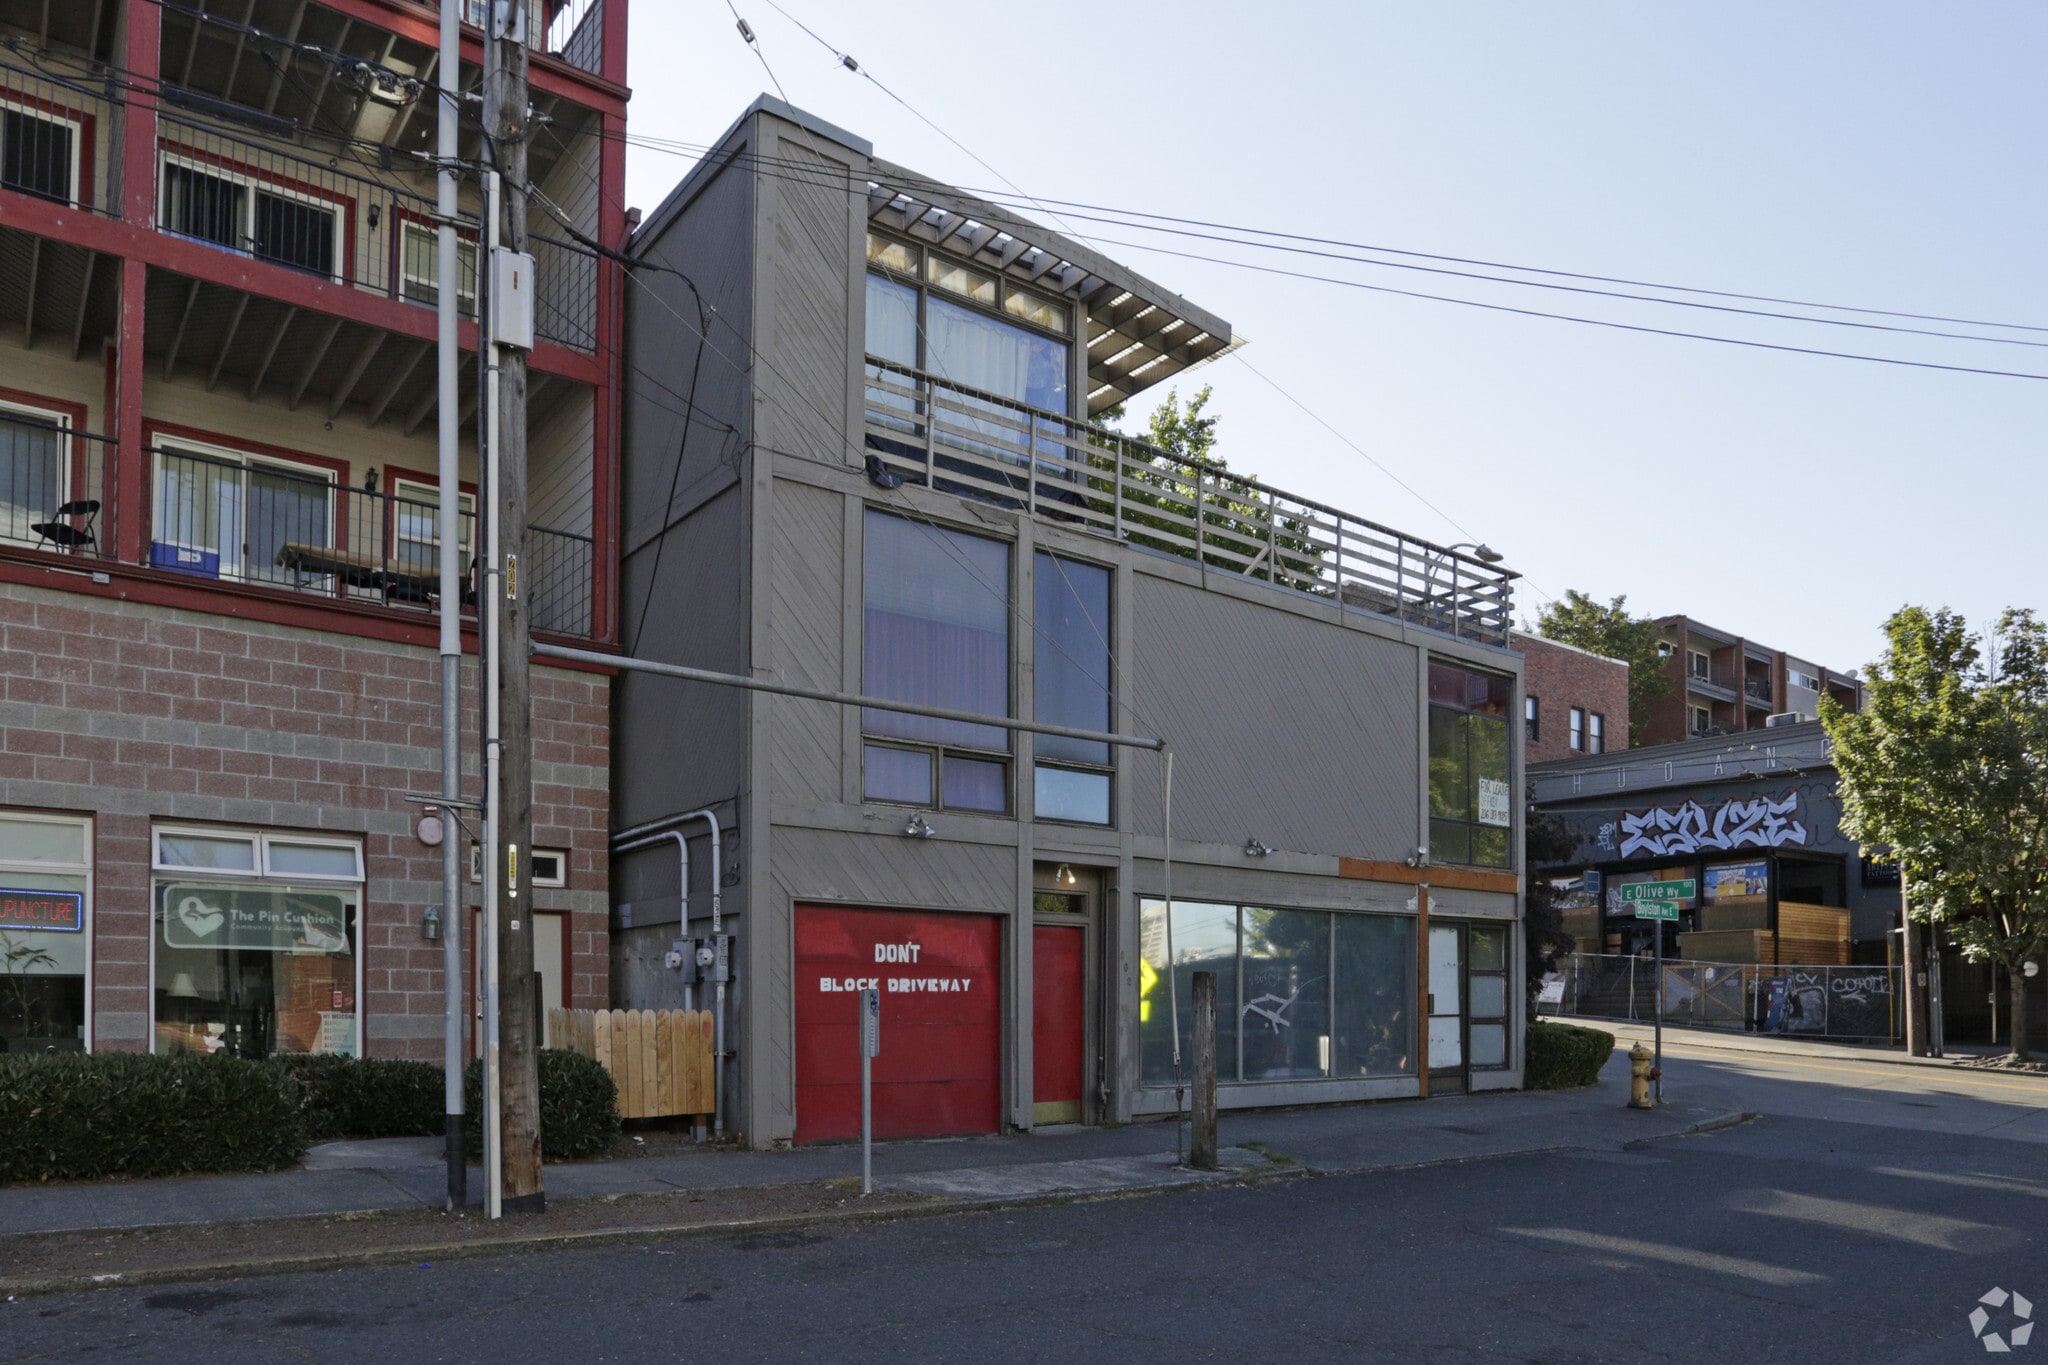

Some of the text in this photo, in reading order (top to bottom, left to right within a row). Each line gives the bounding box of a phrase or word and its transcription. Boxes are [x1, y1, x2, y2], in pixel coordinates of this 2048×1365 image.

[1626, 889, 1632, 899] E
[1635, 885, 1664, 899] Olive
[1667, 887, 1679, 899] Wy
[229, 909, 255, 922] The
[258, 910, 280, 923] Pin
[1637, 900, 1660, 917] Boylston
[875, 941, 921, 964] DON'T
[819, 977, 971, 993] BLOCK DRIVEWAY
